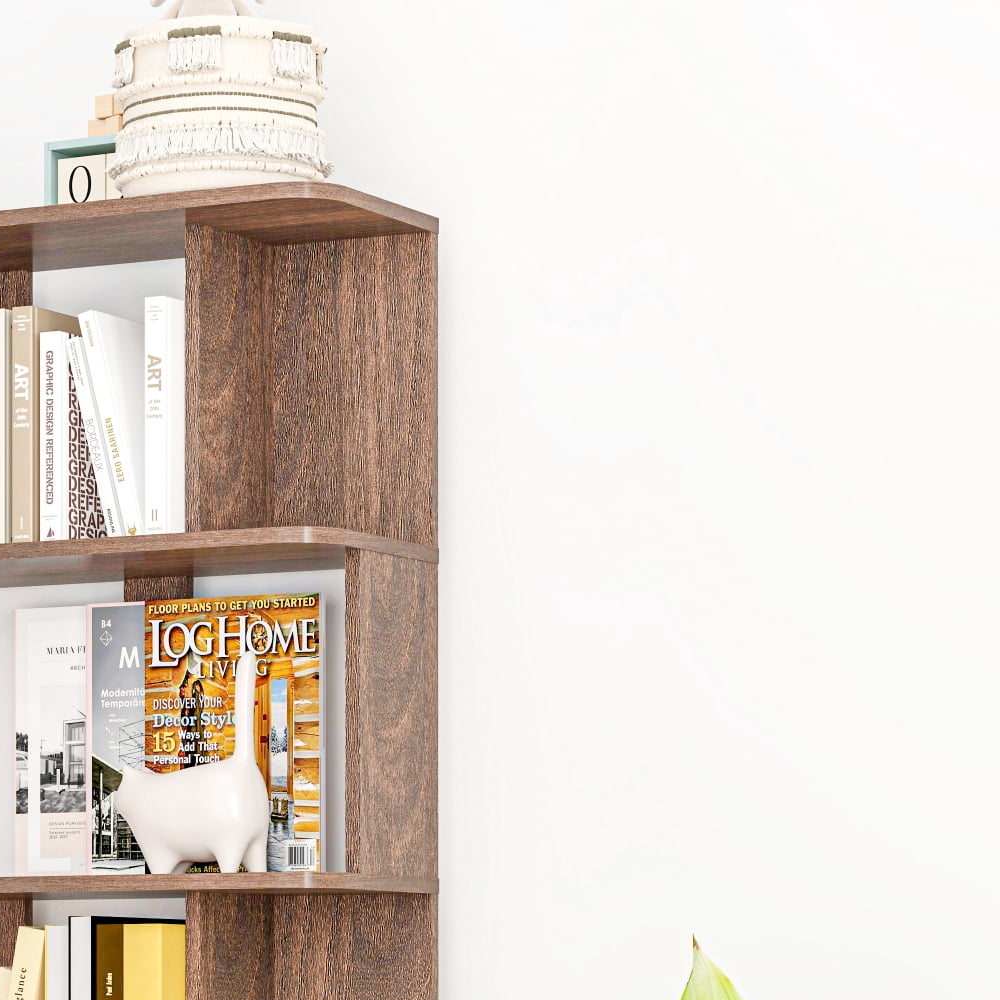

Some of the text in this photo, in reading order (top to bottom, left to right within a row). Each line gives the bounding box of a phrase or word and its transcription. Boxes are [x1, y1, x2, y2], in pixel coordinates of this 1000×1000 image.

[14, 363, 29, 401] ART
[46, 350, 54, 396] GRAPHIC
[147, 354, 162, 391] ART
[46, 398, 54, 435] DESIGN
[104, 417, 125, 483] EERO SAARINEN
[46, 439, 54, 505] REFERENCED
[148, 597, 315, 615] FLOOR PLANS TO GET YOU STARTED
[47, 646, 75, 655] MARIA
[199, 658, 271, 679] LIVIG
[153, 696, 223, 710] DISCOVER YOUR
[153, 714, 197, 728] Decor
[153, 731, 176, 752] 15
[178, 729, 212, 740] Ways to
[178, 741, 218, 752] Add That
[153, 753, 220, 765] Personal Touch
